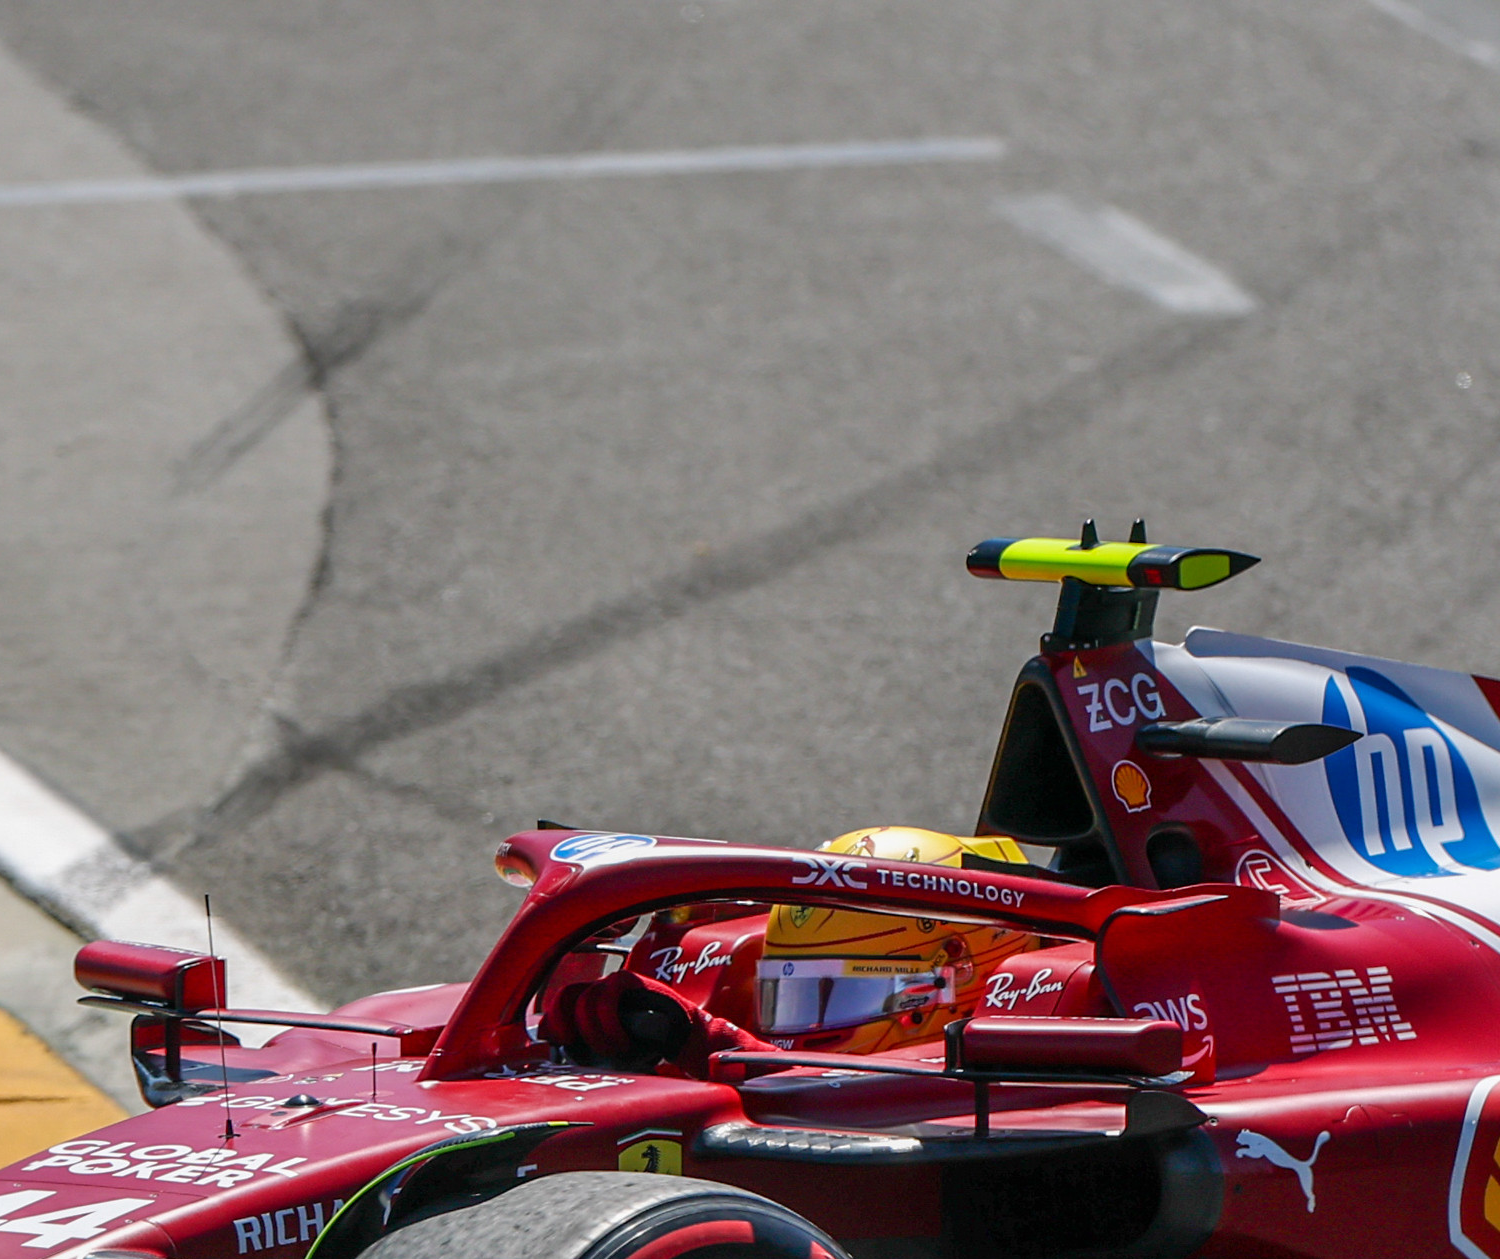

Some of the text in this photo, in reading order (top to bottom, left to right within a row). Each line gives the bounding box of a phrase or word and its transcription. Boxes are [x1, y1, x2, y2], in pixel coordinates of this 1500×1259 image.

[1333, 671, 1465, 869] hp
[791, 856, 1025, 908] DXC TECHNOLOGY
[852, 965, 893, 974] RICHARD
[1271, 966, 1418, 1054] IBM
[21, 1155, 255, 1188] POKER
[49, 1140, 308, 1178] GLOBAL
